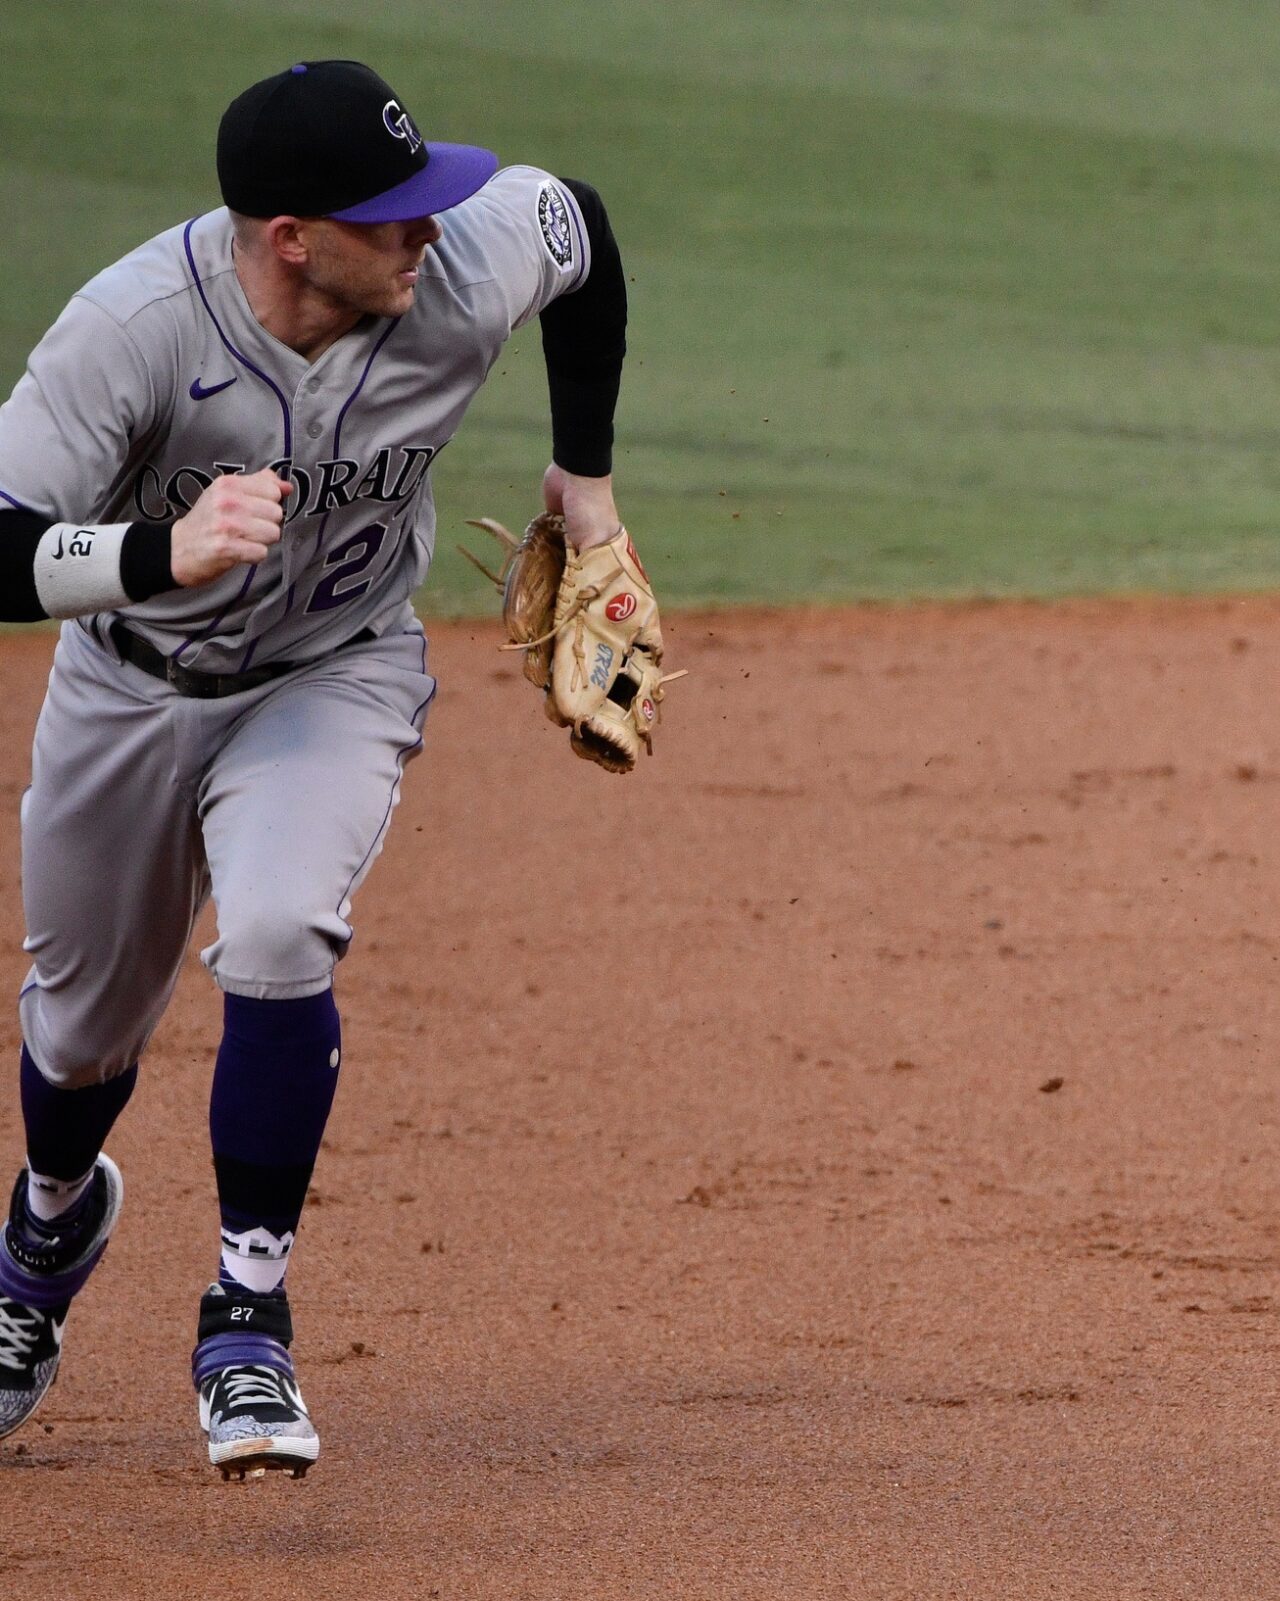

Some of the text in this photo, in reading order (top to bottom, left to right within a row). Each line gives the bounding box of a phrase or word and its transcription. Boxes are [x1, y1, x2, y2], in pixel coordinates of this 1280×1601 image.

[134, 438, 453, 522] COORAD
[69, 530, 96, 557] 27
[230, 1306, 254, 1321] 27
